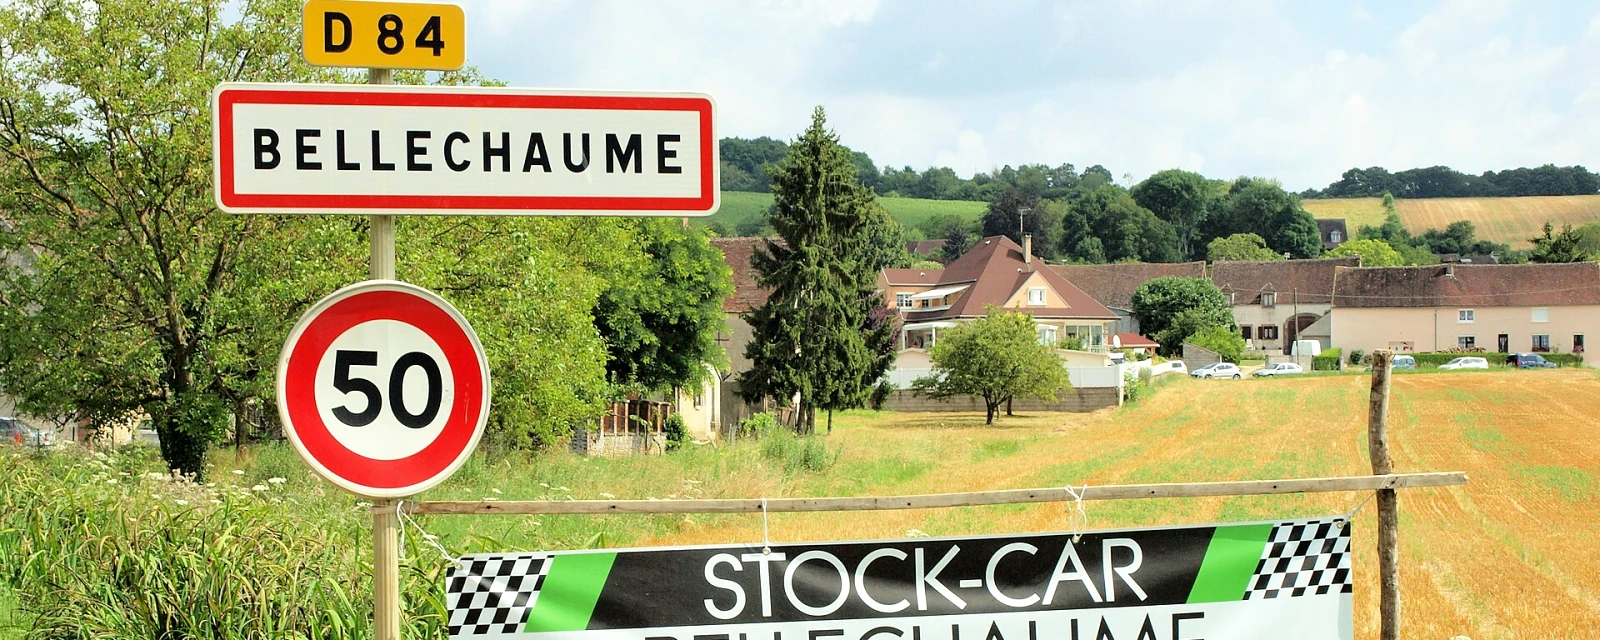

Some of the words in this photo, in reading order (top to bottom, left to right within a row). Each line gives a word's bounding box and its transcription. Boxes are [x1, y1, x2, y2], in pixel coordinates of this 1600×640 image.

[324, 11, 353, 53] D
[377, 13, 446, 57] 84
[253, 128, 683, 174] BELLECHAUME
[331, 350, 443, 429] 50
[703, 538, 1148, 620] STOCK-CAR
